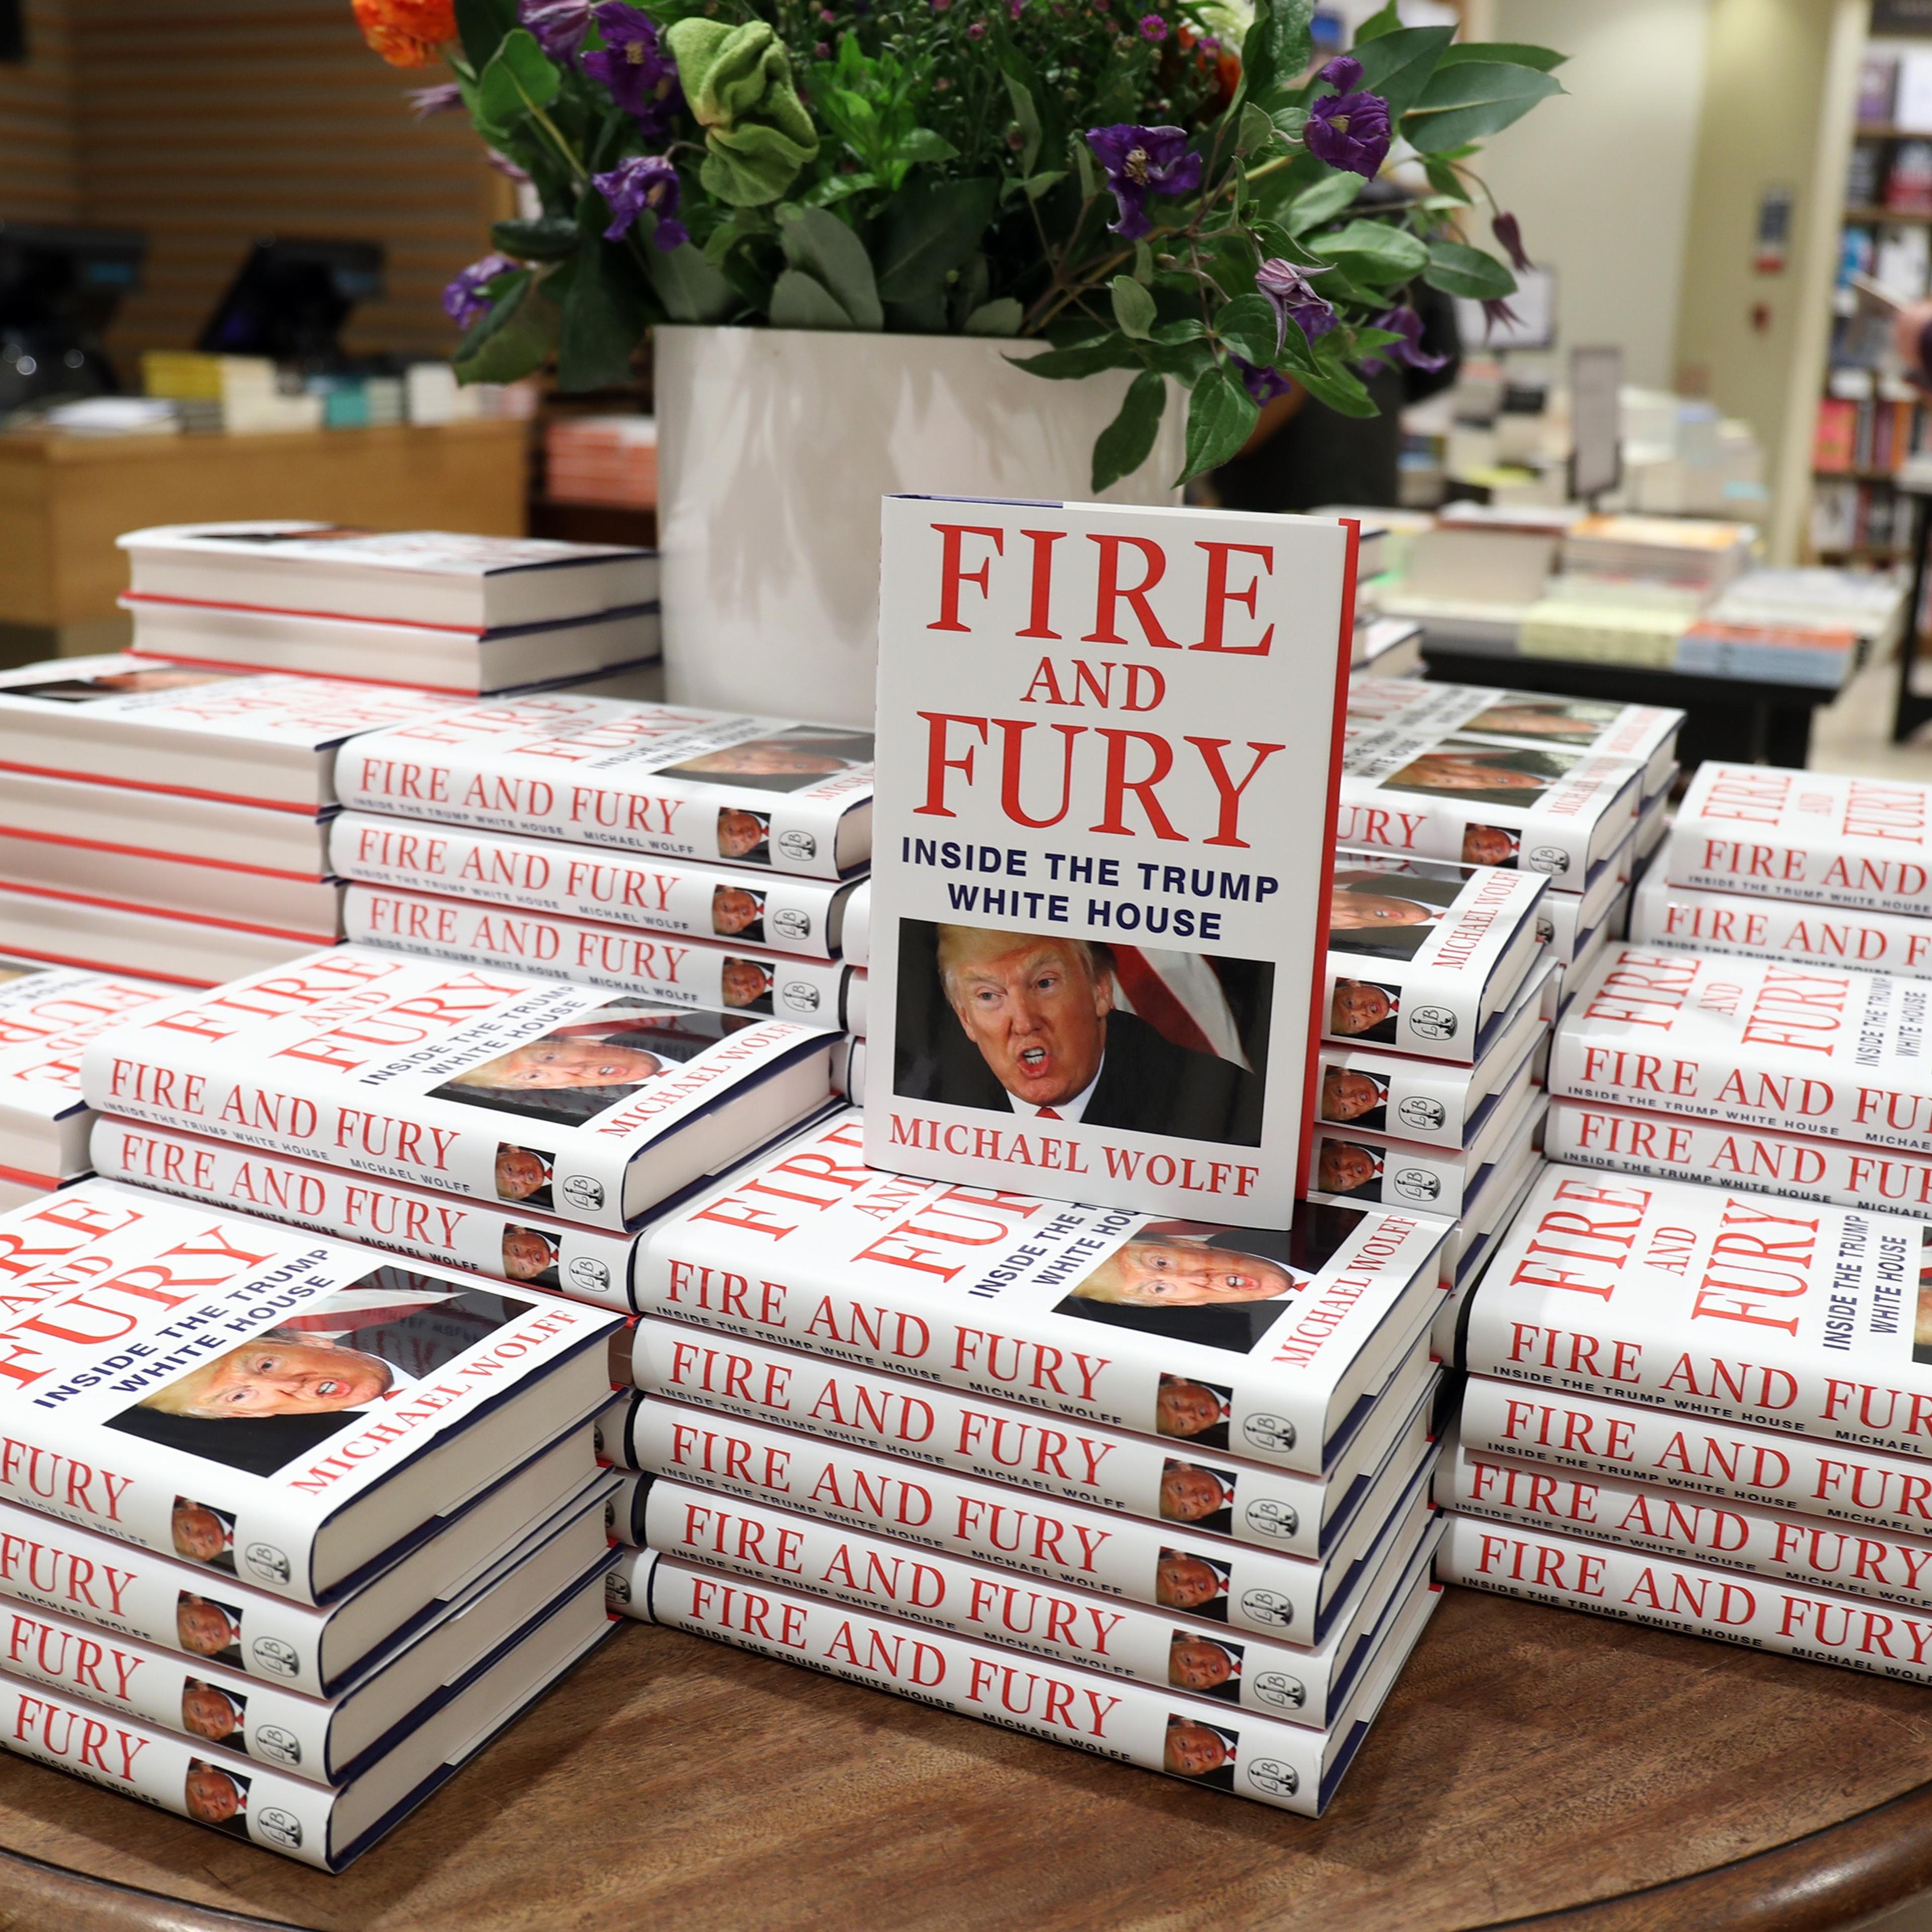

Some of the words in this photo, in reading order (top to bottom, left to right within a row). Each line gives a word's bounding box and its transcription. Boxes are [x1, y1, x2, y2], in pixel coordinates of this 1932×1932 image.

[926, 523, 1275, 656] FIRE
[1019, 657, 1165, 711] AND
[360, 758, 451, 802] FIRE
[463, 774, 553, 816] AND
[570, 786, 685, 836] FURY
[913, 711, 1286, 848] FURY
[1701, 770, 1792, 826] FIRE
[1842, 781, 1925, 845] FURY
[353, 798, 395, 811] INSIDE
[399, 806, 423, 816] THE
[427, 810, 470, 823] TRUMP
[477, 816, 516, 828] WHITE
[521, 822, 564, 835] HOUSE
[583, 831, 643, 847] MICHAEL
[648, 841, 694, 854] WOLFF
[1701, 838, 1807, 882] FIRE
[1821, 855, 1927, 896] AND
[357, 829, 447, 875] FIRE
[459, 847, 549, 890] AND
[565, 861, 681, 912] FURY
[902, 837, 1026, 876] INSIDE
[1045, 853, 1120, 887] THE
[1137, 863, 1279, 904] TRUMP
[948, 883, 1069, 923] WHITE
[1088, 901, 1222, 940] HOUSE
[1688, 875, 1735, 889] INSIDE
[1742, 881, 1768, 893] THE
[1776, 886, 1824, 899] TRUMP
[1830, 893, 1875, 906] WHITE
[1882, 900, 1930, 913] HOUSE
[370, 897, 457, 944] FIRE
[470, 916, 560, 960] AND
[576, 932, 689, 983] FURY
[1432, 910, 1498, 970] MICHAEL
[1474, 871, 1523, 905] WOLFF
[1663, 904, 1768, 947] FIRE
[1781, 921, 1887, 960] AND
[141, 956, 404, 1043] FIRE
[268, 973, 531, 1073] FURY
[300, 992, 390, 1027] AND
[1583, 950, 1702, 1032] FIRE
[1697, 982, 1743, 1016] AND
[1741, 965, 1850, 1057] FURY
[1863, 1010, 1887, 1027] THE
[1901, 991, 1926, 1024] HOUSE
[360, 1045, 451, 1085] INSIDE
[448, 1022, 505, 1043] THE
[498, 986, 576, 1021] TRUMP
[422, 1040, 509, 1076] WHITE
[504, 1000, 587, 1039] HOUSE
[1855, 1030, 1884, 1067] INSIDE
[1895, 1025, 1922, 1057] WHITE
[109, 1058, 205, 1116] FIRE
[218, 1085, 317, 1139] AND
[334, 1107, 461, 1171] FURY
[596, 1065, 732, 1138] MICHAEL
[717, 1024, 806, 1066] WOLFF
[1568, 1087, 1619, 1101] INSIDE
[1628, 1095, 1656, 1107] THE
[1664, 1101, 1719, 1116] TRUMP
[1726, 1111, 1777, 1126] WHITE
[1785, 1121, 1839, 1136] HOUSE
[1580, 1046, 1698, 1097] FIRE
[1715, 1068, 1833, 1117] AND
[104, 1101, 148, 1120] INSIDE
[153, 1110, 178, 1125] THE
[182, 1119, 228, 1137] TRUMP
[235, 1131, 277, 1149] WHITE
[282, 1143, 329, 1160] HOUSE
[350, 1158, 415, 1181] MICHAEL
[421, 1174, 470, 1193] WOLFF
[889, 1114, 1088, 1174] MICHAEL
[1101, 1146, 1260, 1196] WOLFF
[1576, 1112, 1693, 1165] FIRE
[1711, 1136, 1826, 1184] AND
[122, 1134, 215, 1192] FIRE
[229, 1162, 326, 1217] AND
[344, 1185, 468, 1251] FURY
[968, 1244, 1048, 1298] INSIDE
[1035, 1213, 1085, 1241] THE
[1031, 1237, 1105, 1286] WHITE
[1509, 1179, 1652, 1302] FIRE
[1644, 1227, 1697, 1276] AND
[1691, 1197, 1819, 1336] FURY
[1833, 1263, 1862, 1289] THE
[1838, 1215, 1869, 1258] TRUMP
[1877, 1236, 1906, 1282] HOUSE
[0, 1256, 113, 1315] AND
[0, 1225, 278, 1390] FURY
[1271, 1276, 1372, 1369] MICHAEL
[1347, 1214, 1417, 1272] WOLFF
[1823, 1295, 1857, 1350] INSIDE
[1870, 1285, 1901, 1333] WHITE
[32, 1342, 157, 1409] INSIDE
[155, 1306, 229, 1338] THE
[224, 1249, 328, 1301] TRUMP
[109, 1335, 226, 1393] WHITE
[223, 1275, 335, 1332] HOUSE
[656, 1307, 710, 1327] INSIDE
[717, 1321, 749, 1335] THE
[755, 1330, 813, 1349] TRUMP
[820, 1346, 874, 1365] WHITE
[883, 1361, 942, 1382] HOUSE
[969, 1382, 1051, 1408] MICHAEL
[1059, 1403, 1122, 1424] WOLFF
[666, 1259, 787, 1328] FIRE
[803, 1295, 929, 1358] AND
[951, 1325, 1112, 1402] FURY
[1506, 1321, 1642, 1384] FIRE
[1658, 1352, 1798, 1409] AND
[287, 1384, 471, 1496] MICHAEL
[460, 1310, 580, 1380] WOLFF
[669, 1341, 792, 1410] FIRE
[807, 1379, 934, 1442] AND
[954, 1409, 1116, 1487] FURY
[1494, 1365, 1552, 1384] INSIDE
[1561, 1378, 1594, 1392] THE
[1604, 1387, 1665, 1405] TRUMP
[1675, 1400, 1732, 1418] WHITE
[1742, 1413, 1805, 1431] HOUSE
[1835, 1430, 1923, 1454] MICHAEL
[1501, 1399, 1636, 1462] FIRE
[1652, 1431, 1790, 1489] AND
[0, 1437, 134, 1523] FURY
[671, 1423, 791, 1493] FIRE
[808, 1463, 932, 1526] AND
[952, 1495, 1113, 1573] FURY
[1468, 1461, 1599, 1523] FIRE
[1616, 1494, 1749, 1552] AND
[1769, 1521, 1932, 1590] FURY
[0, 1532, 137, 1617] FURY
[682, 1503, 804, 1574] FIRE
[820, 1545, 945, 1608] AND
[965, 1577, 1126, 1656] FURY
[1475, 1534, 1606, 1597] FIRE
[1623, 1567, 1756, 1625] AND
[1776, 1595, 1932, 1665] FURY
[7, 1614, 145, 1702] FURY
[689, 1577, 808, 1649] FIRE
[823, 1621, 946, 1686] AND
[965, 1658, 1122, 1738] FURY
[1462, 1577, 1518, 1596] INSIDE
[1527, 1591, 1559, 1604] THE
[1568, 1600, 1628, 1618] TRUMP
[1636, 1615, 1692, 1632] WHITE
[1702, 1628, 1762, 1647] HOUSE
[1792, 1647, 1875, 1671] MICHAEL
[13, 1694, 150, 1783] FURY
